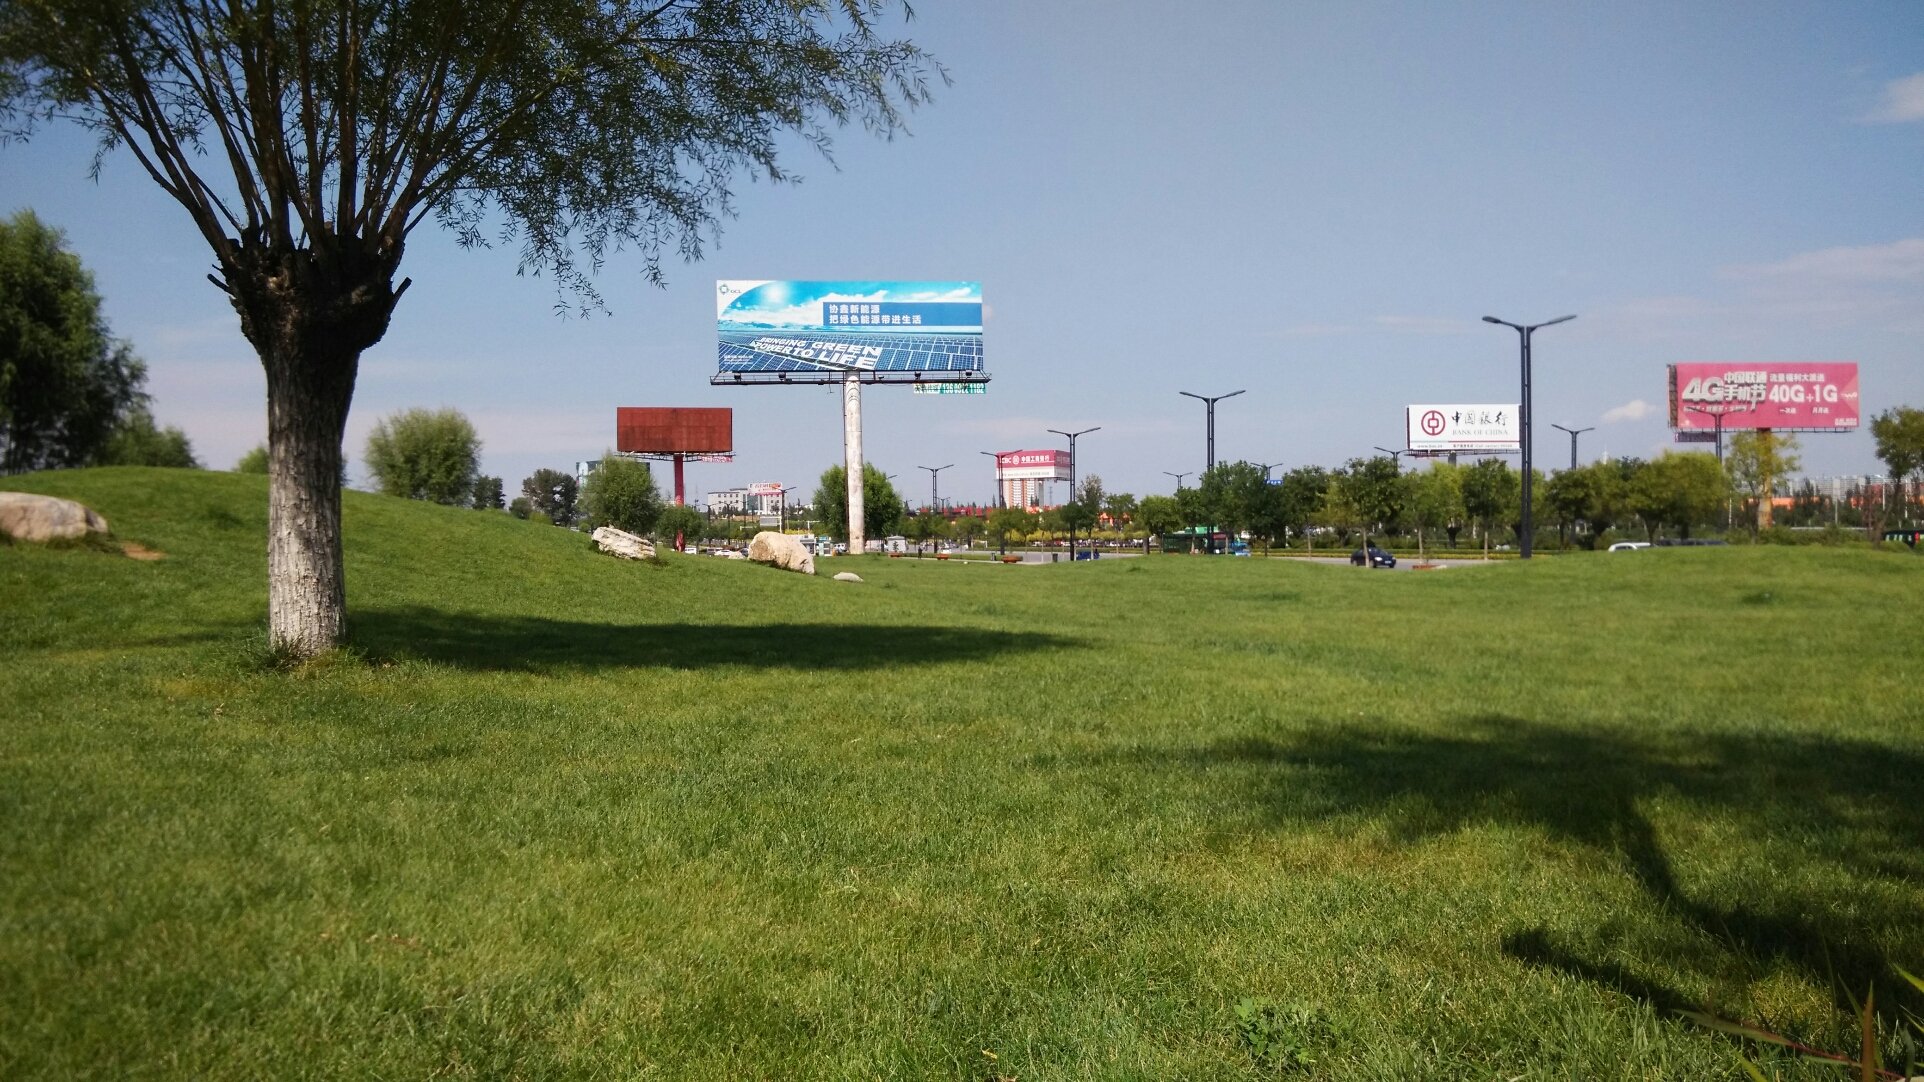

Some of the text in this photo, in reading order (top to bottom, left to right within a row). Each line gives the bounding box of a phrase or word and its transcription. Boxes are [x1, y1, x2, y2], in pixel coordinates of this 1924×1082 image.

[829, 304, 880, 314] 协鑫新能源
[829, 314, 922, 324] 把绿色能源带进生活
[760, 337, 883, 356] BRINGING GREEN
[753, 341, 878, 370] POWER TO LIFE
[1724, 371, 1767, 383] 中国联通
[1682, 377, 1725, 402] 4G
[1724, 384, 1767, 408] 手机节
[1452, 410, 1508, 426] 中国银行
